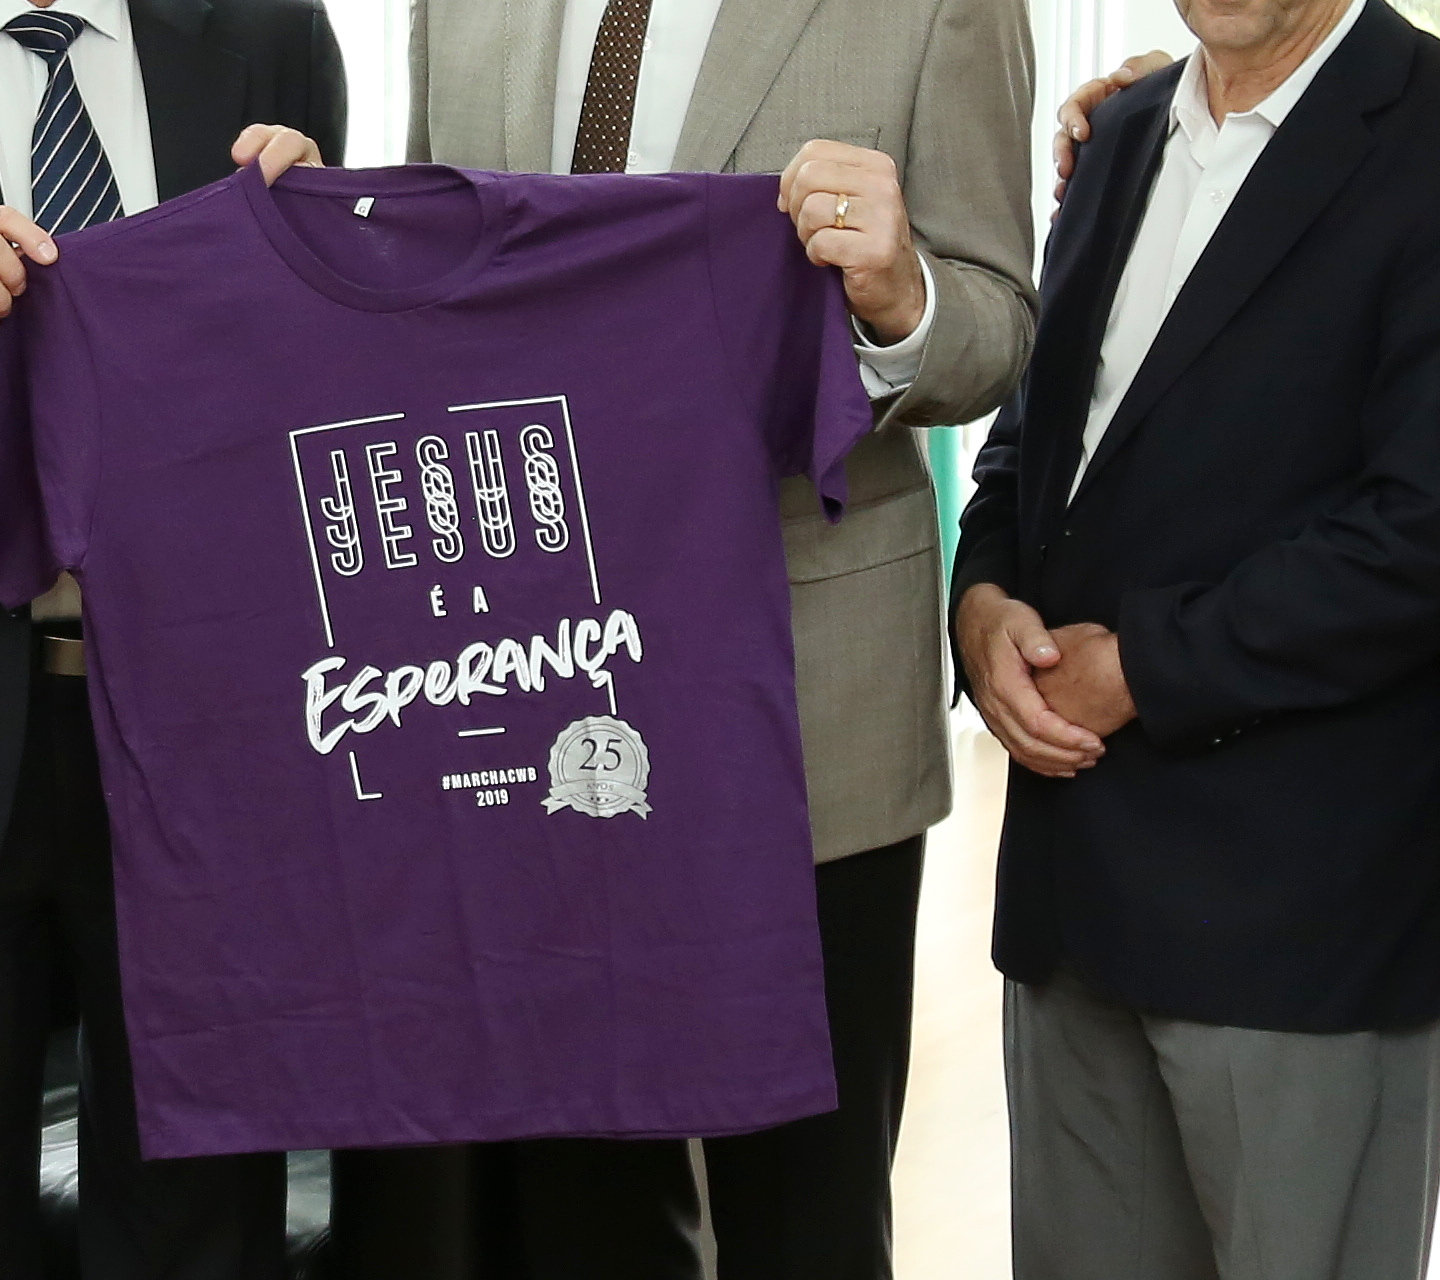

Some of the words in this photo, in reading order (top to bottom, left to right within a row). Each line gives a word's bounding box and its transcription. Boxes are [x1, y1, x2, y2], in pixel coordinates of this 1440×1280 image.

[321, 423, 569, 576] JESUS
[429, 584, 447, 617] É
[473, 585, 489, 613] A
[578, 737, 623, 772] 25
[442, 766, 538, 790] #MARCHACWB
[476, 788, 510, 807] 2019
